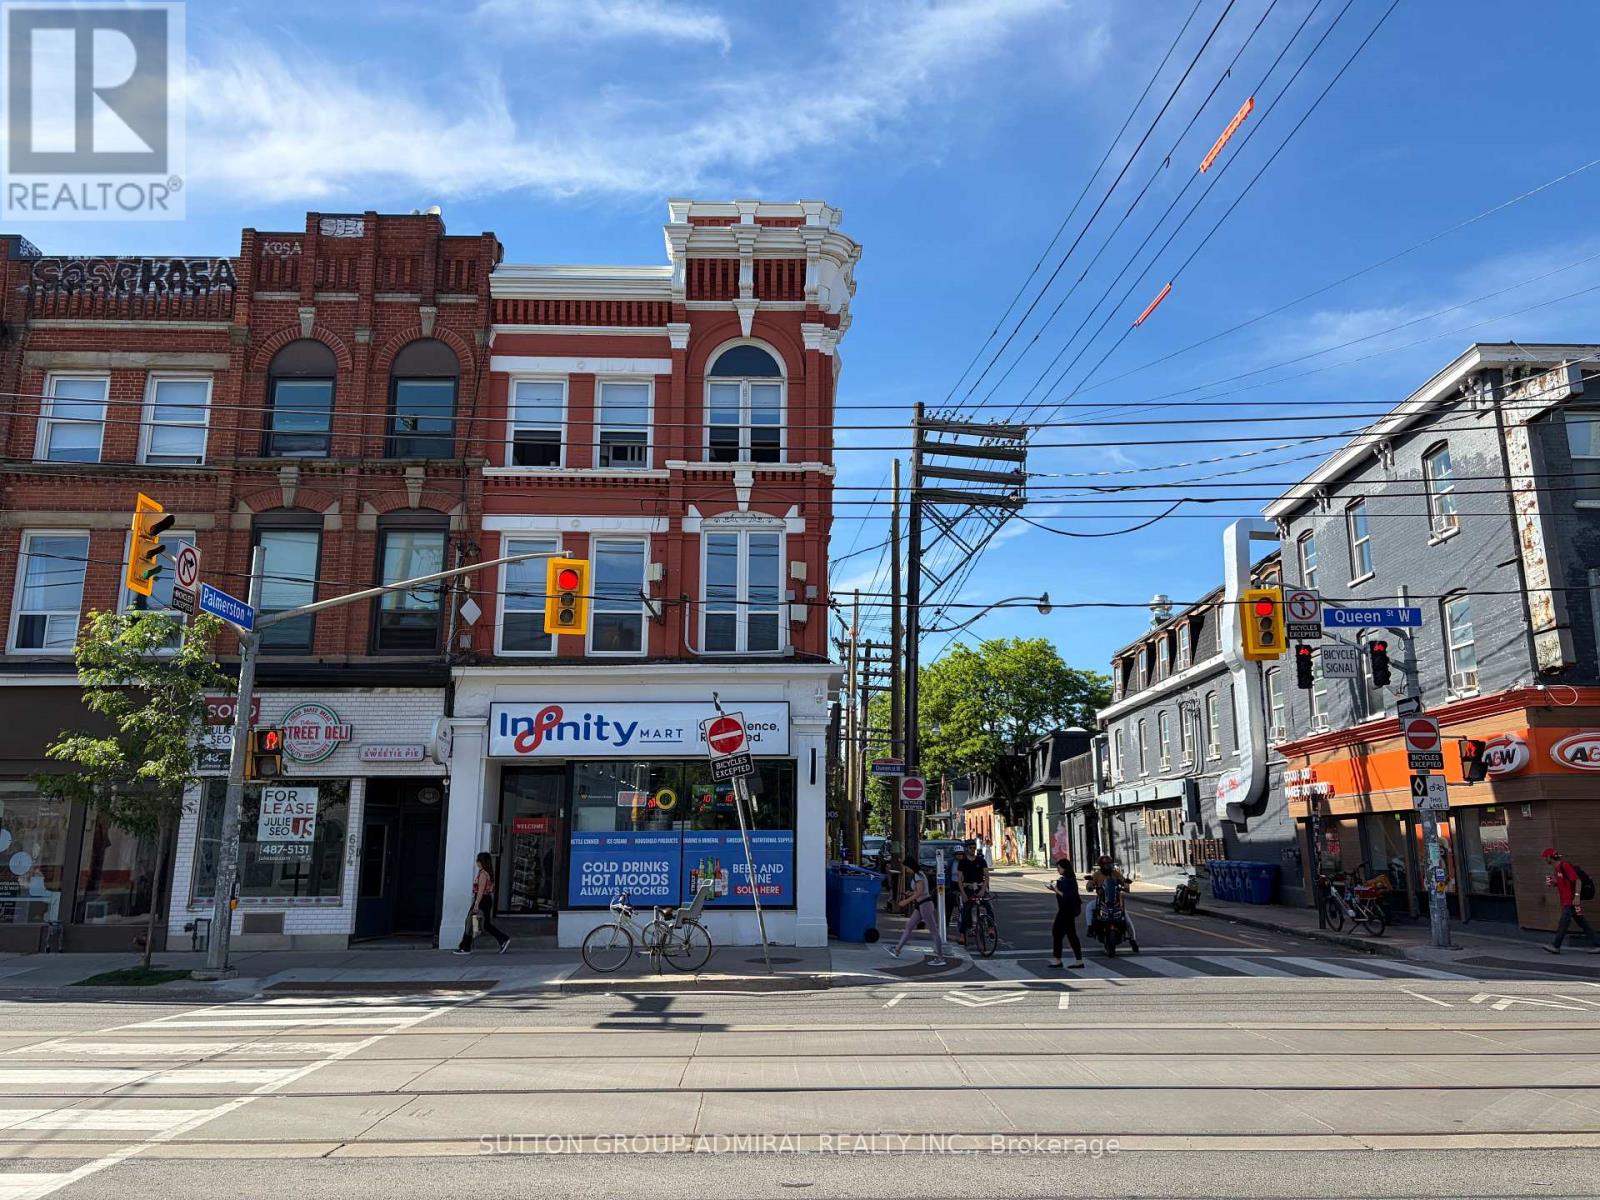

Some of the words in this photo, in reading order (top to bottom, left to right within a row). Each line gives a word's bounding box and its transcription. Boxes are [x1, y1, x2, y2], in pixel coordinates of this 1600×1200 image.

[202, 588, 244, 621] Palmerston
[1334, 610, 1381, 623] Queen
[1398, 609, 1410, 622] W
[1323, 650, 1355, 660] BICYCLE
[1326, 663, 1355, 673] SIGNAL
[324, 726, 350, 740] DELI
[500, 705, 638, 753] Infinity
[640, 728, 684, 738] MART
[210, 735, 231, 744] SEO
[1485, 747, 1516, 768] A&W
[716, 757, 748, 770] BICYCLES
[715, 764, 751, 778] EXCEPTED
[264, 790, 298, 802] FOR
[263, 803, 315, 814] LEASE
[264, 817, 291, 826] JULIE
[268, 827, 290, 836] SEO
[582, 862, 619, 873] COLD
[622, 862, 670, 873] DRINKS
[759, 863, 784, 874] AND
[581, 874, 611, 886] HOT
[614, 874, 669, 886] MOODS
[580, 887, 620, 896] ALWAYS
[622, 886, 670, 896] STOCKED
[760, 886, 780, 894] HERE
